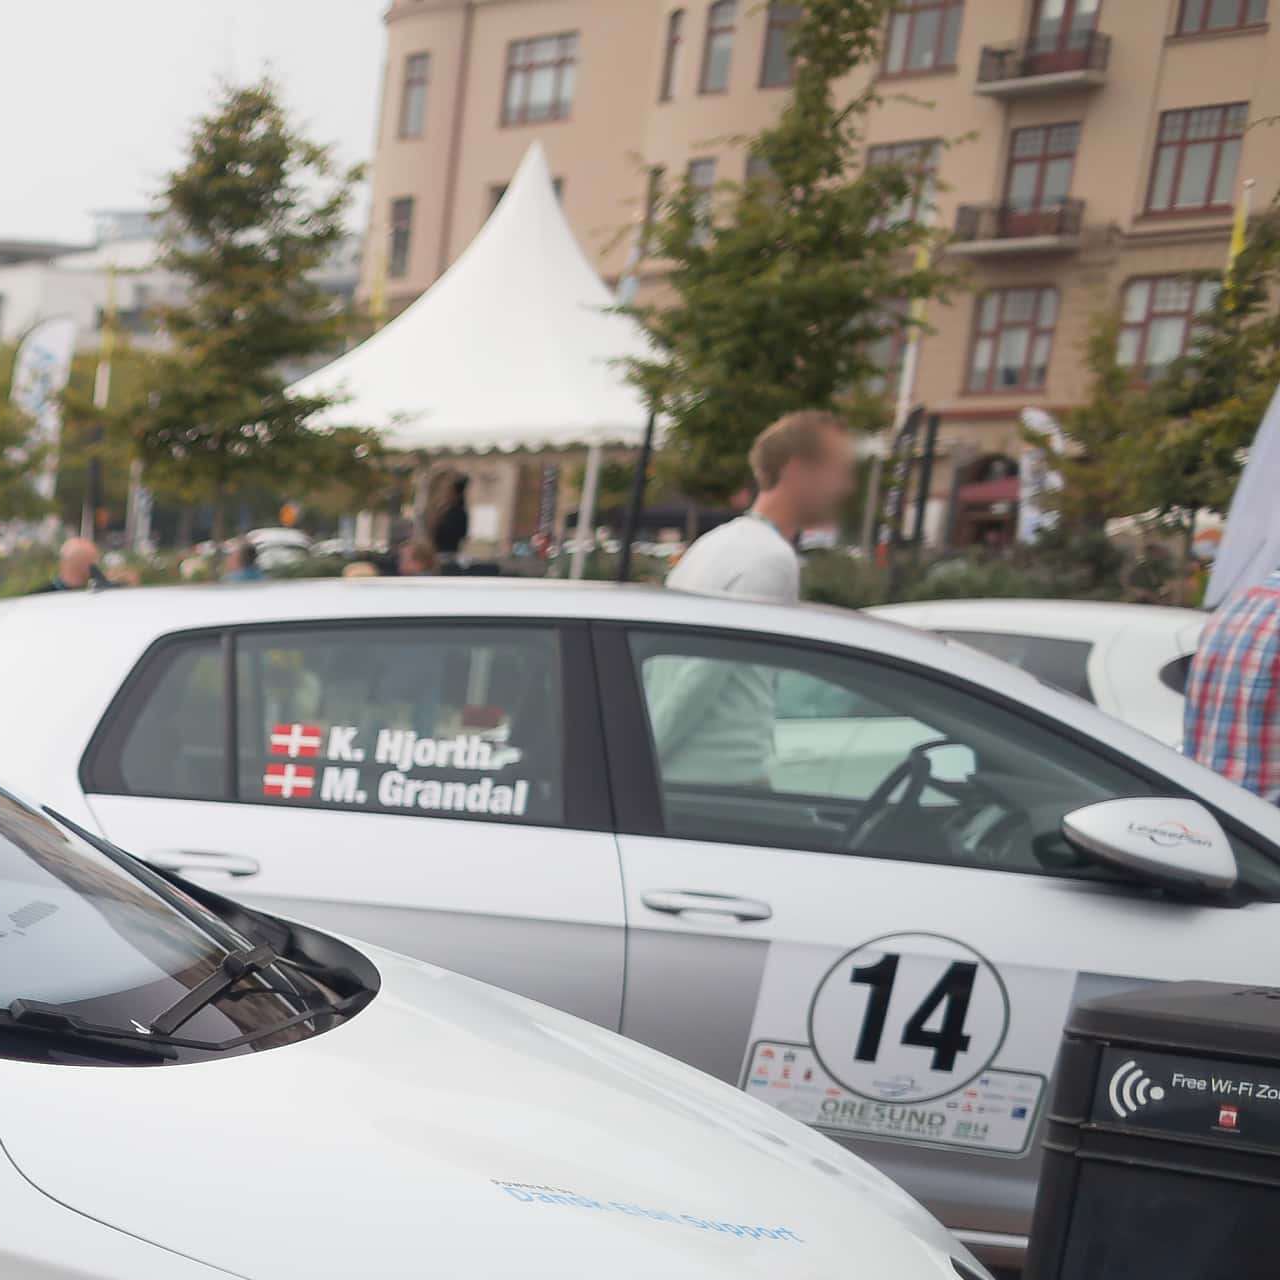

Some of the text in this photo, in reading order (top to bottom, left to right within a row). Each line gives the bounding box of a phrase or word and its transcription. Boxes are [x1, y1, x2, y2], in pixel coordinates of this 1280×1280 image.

[327, 726, 365, 761] K.
[320, 767, 529, 815] M. Grandal
[849, 953, 978, 1073] 14
[1171, 1073, 1280, 1100] Free Wi-Fi Zo
